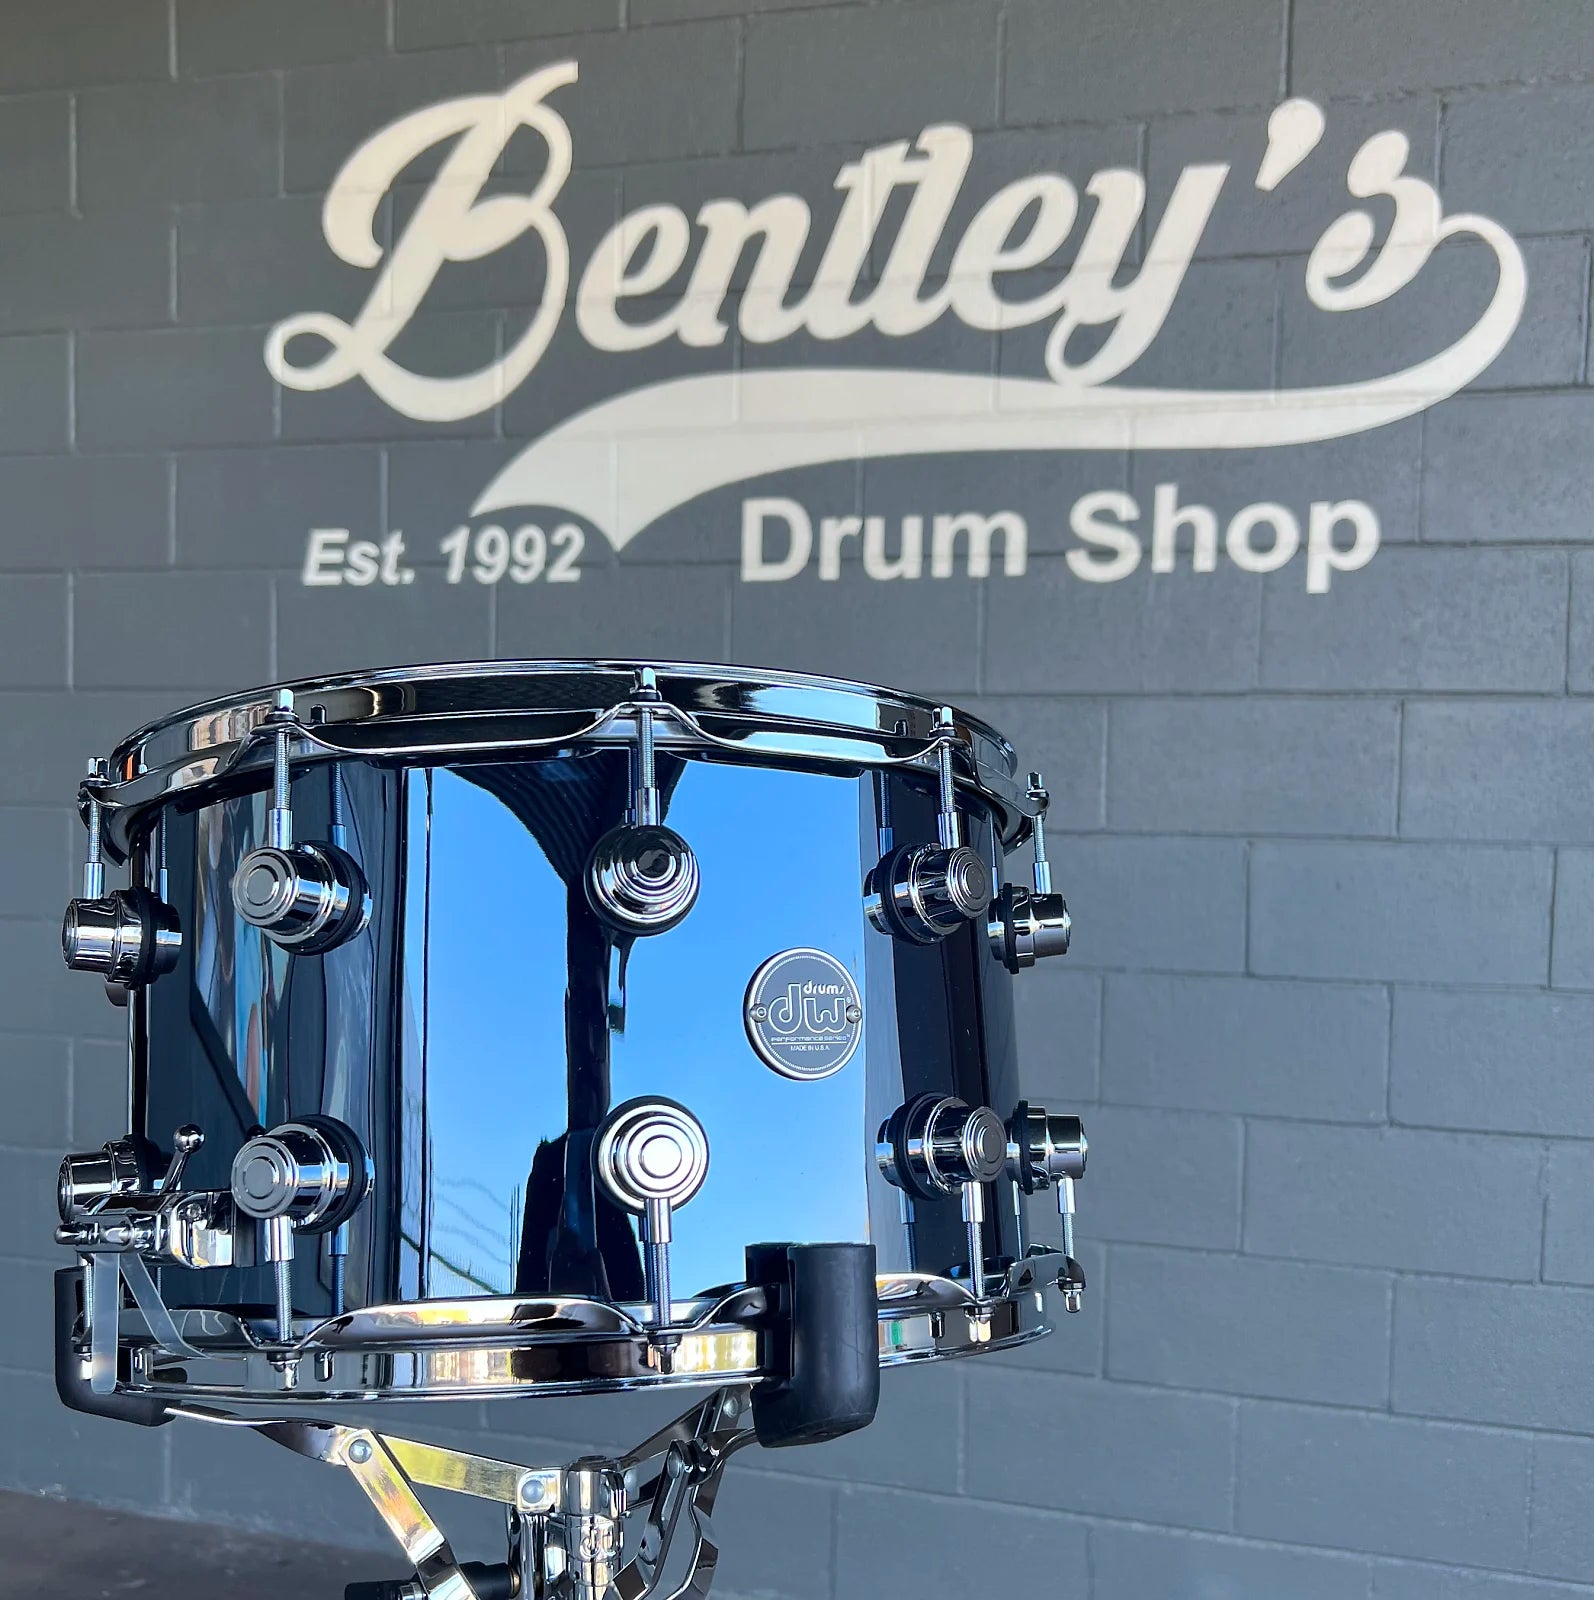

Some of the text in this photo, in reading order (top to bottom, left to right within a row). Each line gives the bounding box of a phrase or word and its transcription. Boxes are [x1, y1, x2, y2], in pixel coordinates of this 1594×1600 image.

[265, 61, 1527, 421] Bentley's
[302, 524, 585, 586] Est. 1992
[741, 482, 1382, 595] Drum Shop
[803, 980, 845, 995] drums
